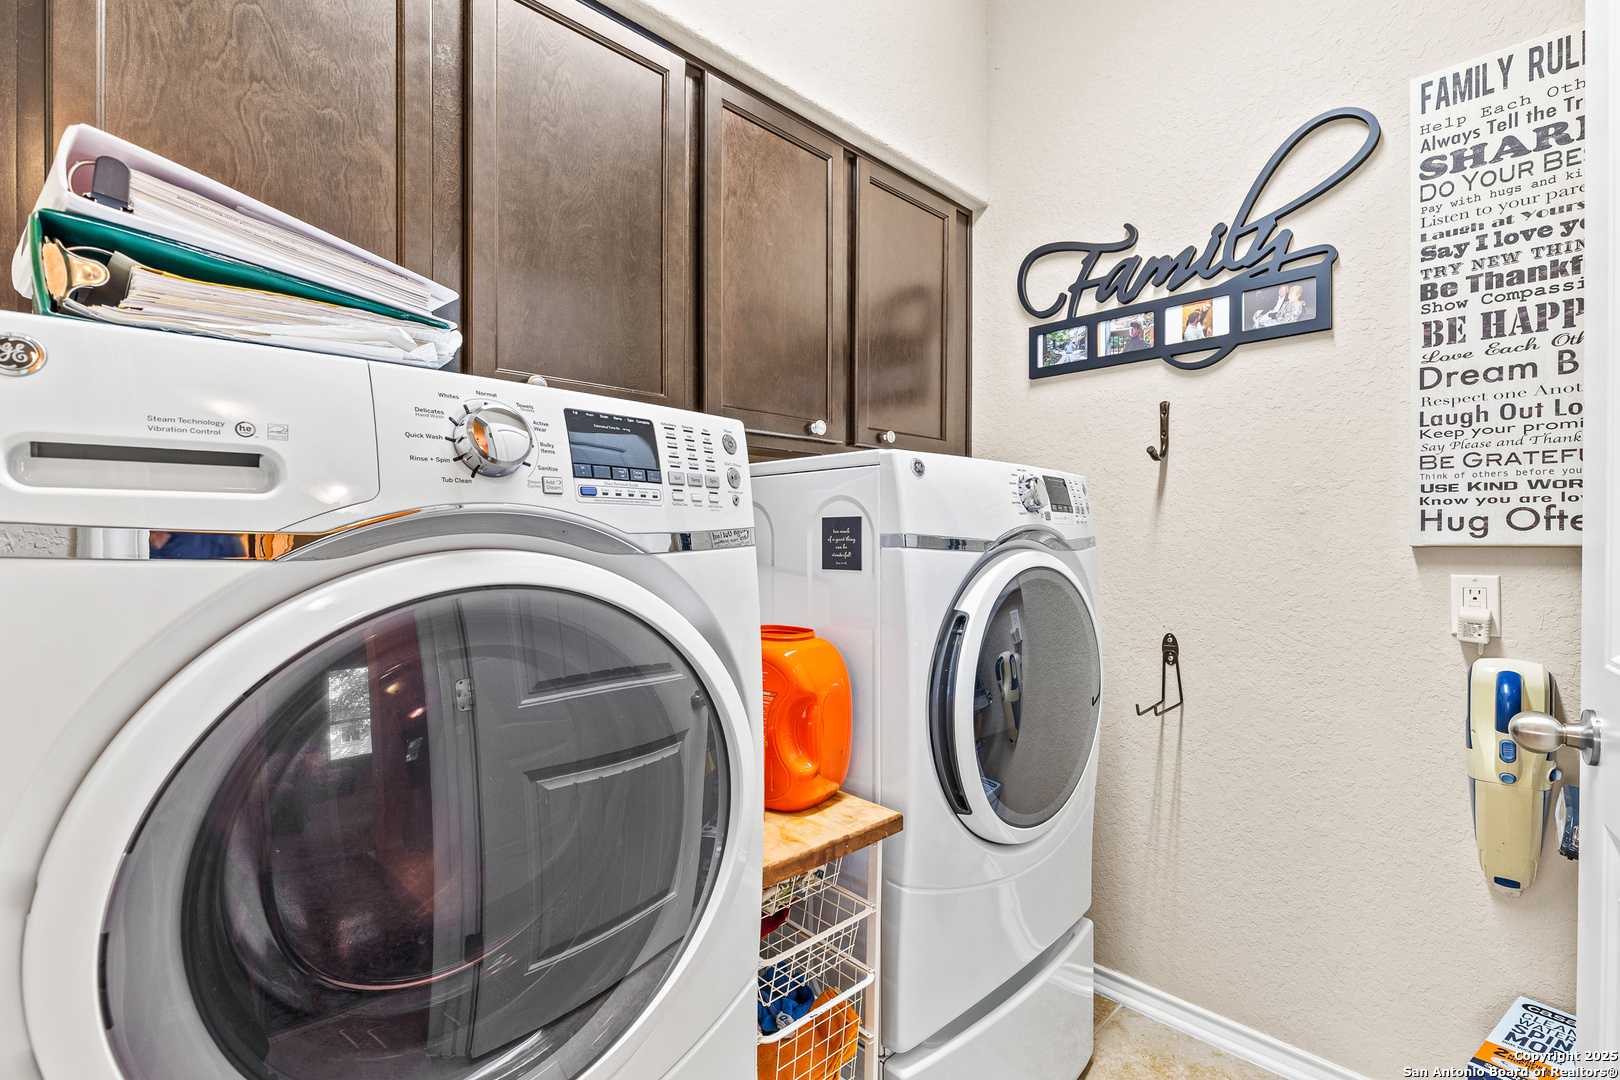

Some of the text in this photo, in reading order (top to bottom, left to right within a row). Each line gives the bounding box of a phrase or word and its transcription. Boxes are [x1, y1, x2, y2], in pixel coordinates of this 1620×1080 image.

[1421, 30, 1585, 115] FAMILY RUL
[1420, 116, 1467, 136] Help
[1480, 95, 1532, 118] Each
[1420, 96, 1584, 154] Always Tell the Tr
[1420, 147, 1585, 203] DO YOUR BE
[1421, 203, 1443, 215] Pay
[1450, 194, 1481, 208] with
[1490, 184, 1522, 198] hugs
[1531, 174, 1557, 189] and
[1017, 106, 1381, 320] Family
[1420, 210, 1470, 229] Listen
[1476, 206, 1492, 216] to
[1498, 194, 1540, 215] your
[1420, 222, 1485, 242] Laugh
[1491, 214, 1515, 228] at
[1420, 241, 1470, 263] Say
[1475, 233, 1488, 252] I
[1493, 224, 1554, 248] love
[1420, 238, 1585, 280] TRY NEW THIN
[1420, 254, 1583, 302] Be Thankf
[1420, 276, 1584, 315] Show Compassi
[1421, 297, 1584, 348] BE HAPP
[1421, 349, 1475, 364] Love
[1484, 336, 1541, 355] Each
[1420, 349, 1579, 390] Dream B
[437, 392, 459, 400] Whites
[475, 390, 497, 398] Normal
[1421, 383, 1583, 408] Respect one Anot
[147, 414, 225, 427] Steam Technology
[414, 406, 445, 415] Delicates
[1420, 398, 1583, 428] Laugh Out Lo
[147, 424, 221, 436] Vibration Control
[405, 431, 424, 439] Quick
[1420, 417, 1584, 440] Keep your promi
[1420, 430, 1582, 455] Say Please and Thank
[1419, 467, 1582, 480] Think of others before you
[1420, 448, 1584, 471] BE GRATEF
[1419, 491, 1583, 507] Know you are lo
[1420, 478, 1583, 494] USE KIND WOR
[1420, 508, 1489, 539] Hug
[1511, 1024, 1574, 1052] SPIN
[1519, 1017, 1577, 1043] WATER
[1521, 1012, 1577, 1037] CLEAN
[1493, 1047, 1509, 1058] 2
